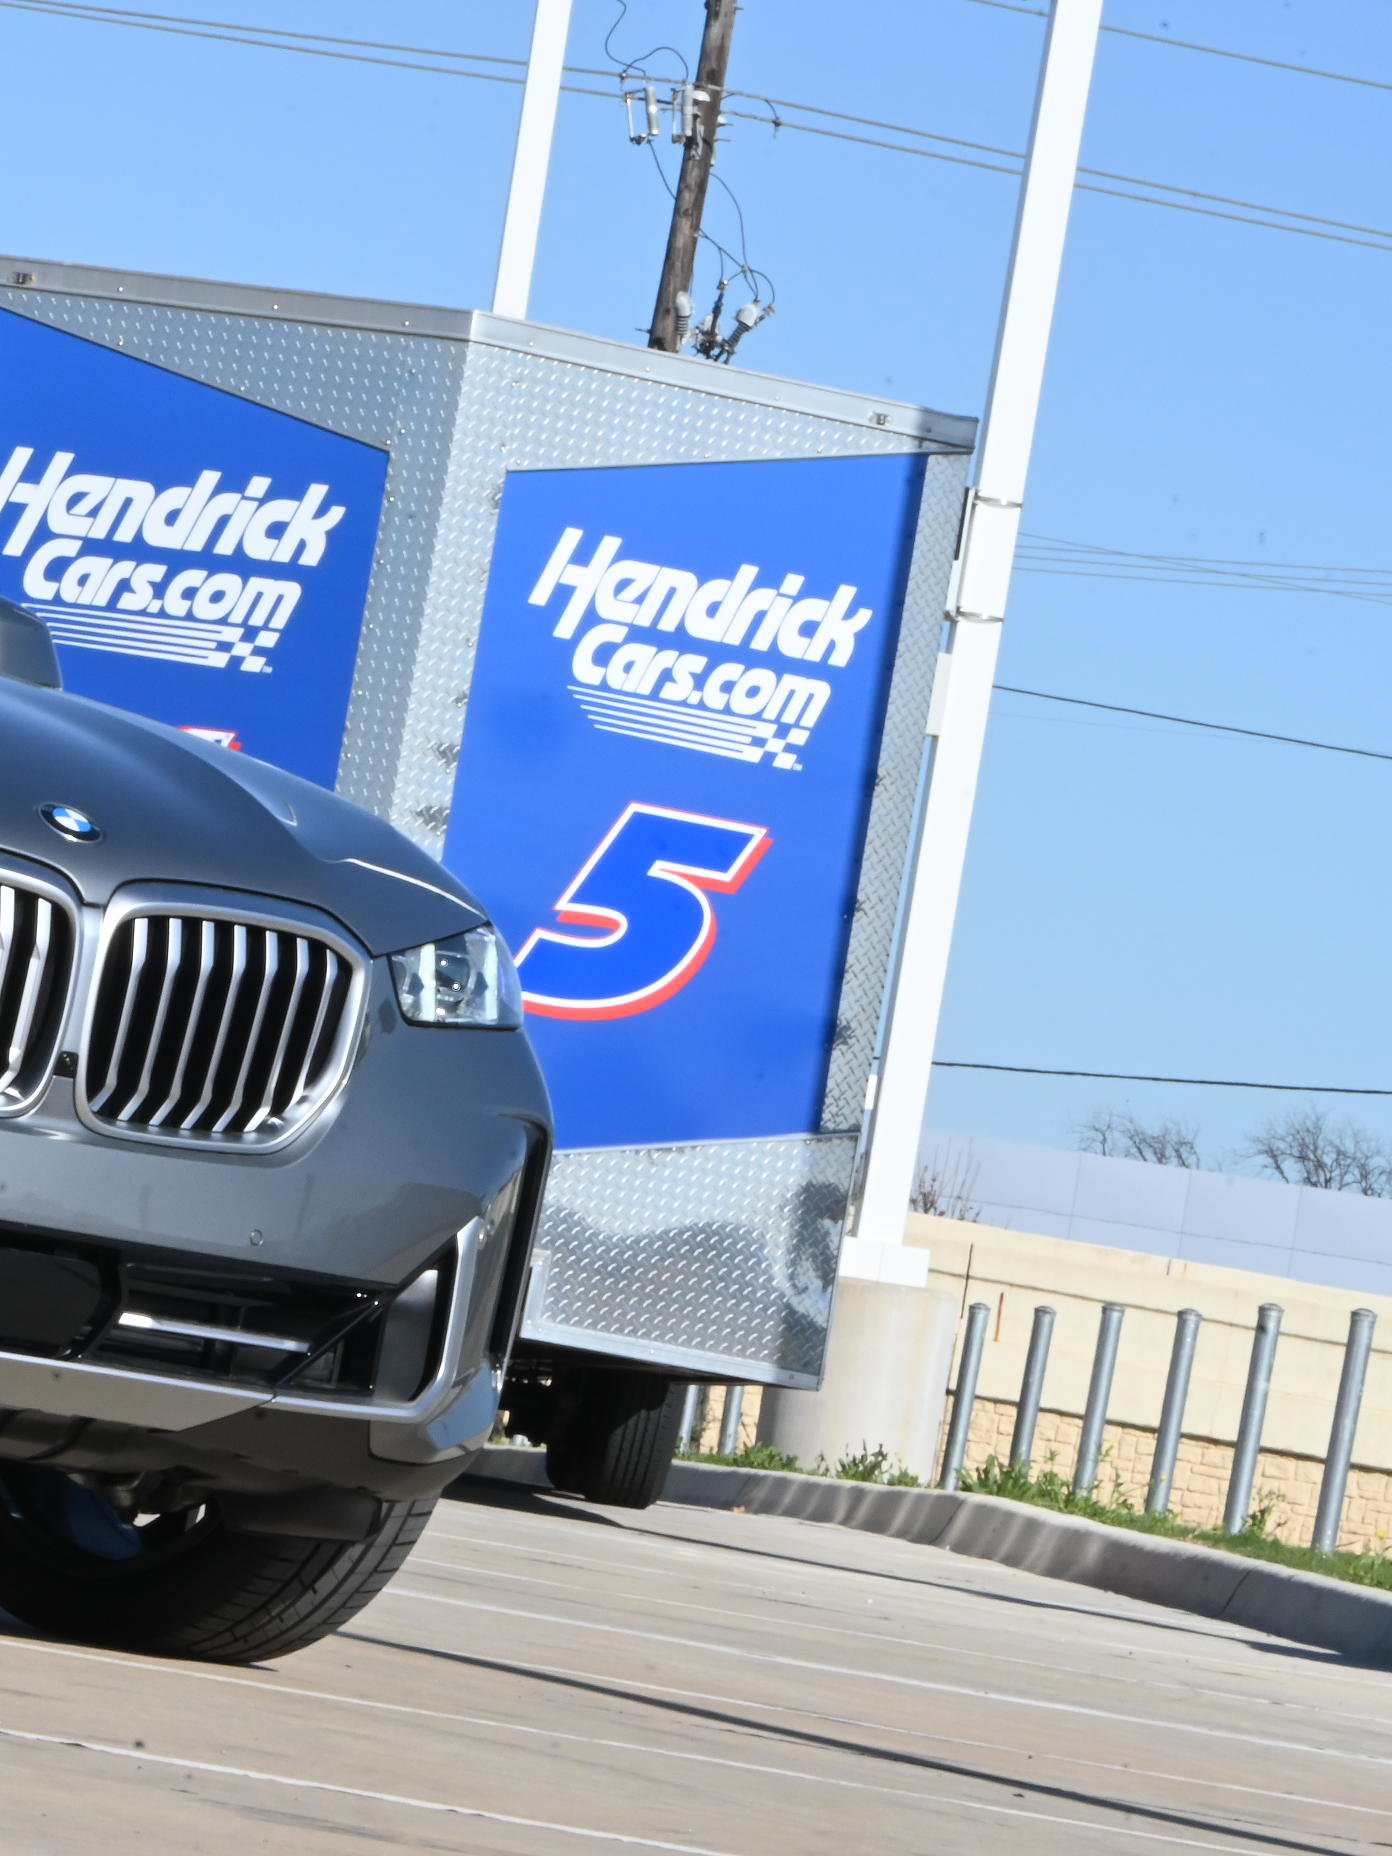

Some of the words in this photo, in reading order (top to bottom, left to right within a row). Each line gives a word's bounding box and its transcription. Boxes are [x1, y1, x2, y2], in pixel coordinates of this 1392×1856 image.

[22, 537, 302, 630] Cars.com
[527, 526, 873, 668] Hendrick
[571, 622, 832, 729] Cars.com
[514, 801, 774, 1021] 5
